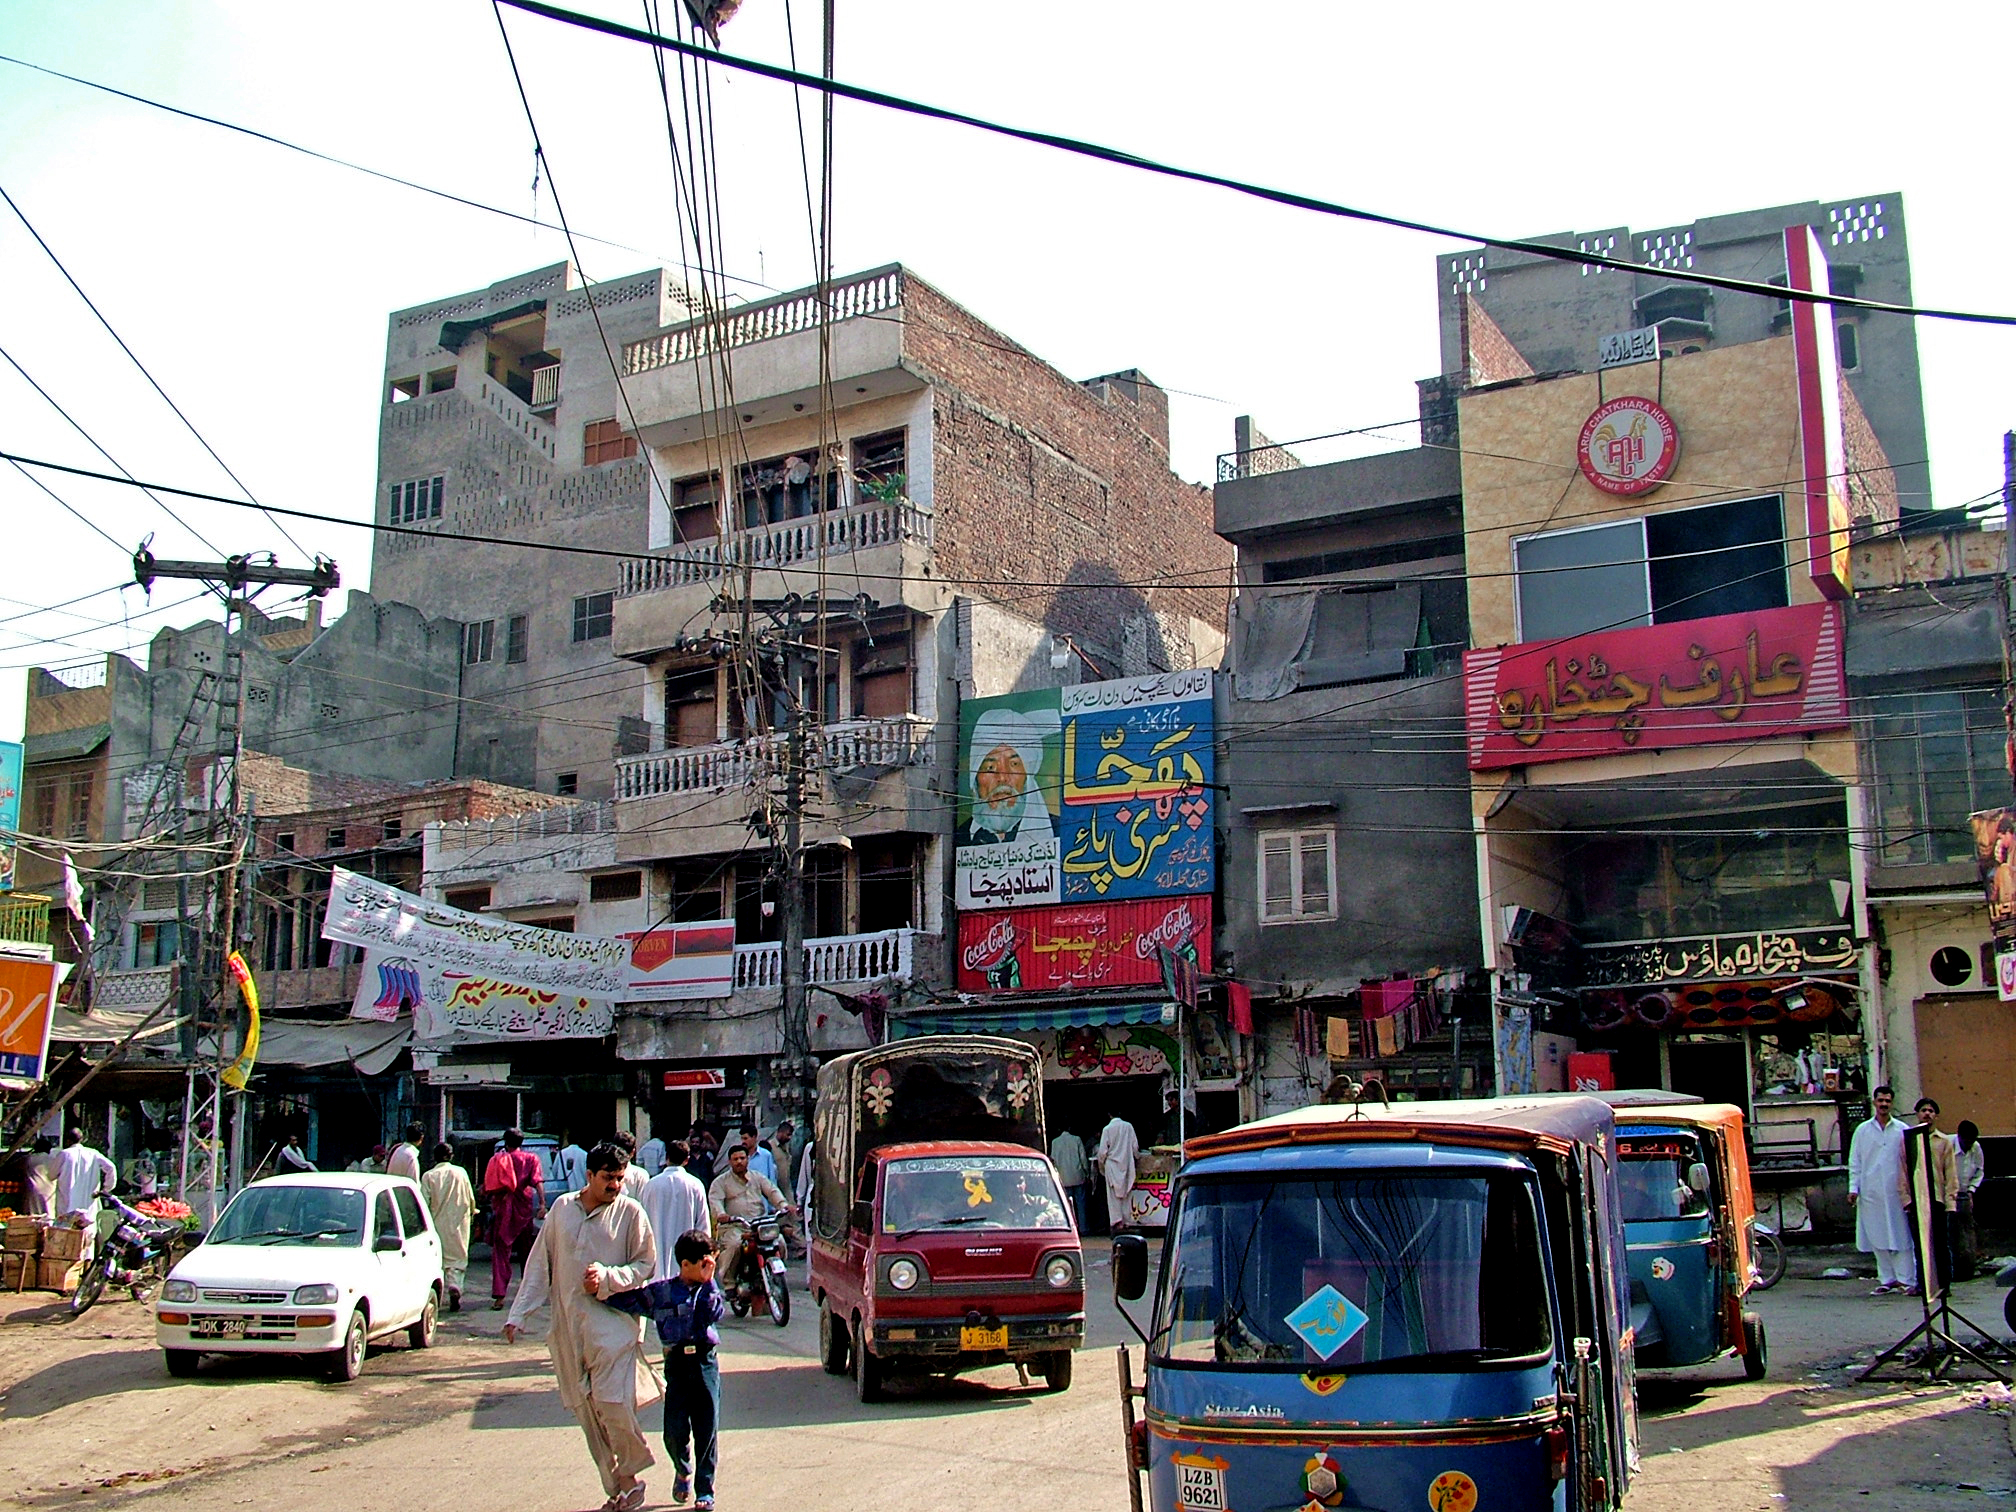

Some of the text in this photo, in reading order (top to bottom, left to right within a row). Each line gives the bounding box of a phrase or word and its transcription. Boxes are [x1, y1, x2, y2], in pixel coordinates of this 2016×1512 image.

[1580, 400, 1673, 454] ARIF CHATKHARA HOUSE
[1598, 477, 1620, 490] NAME
[1624, 482, 1635, 491] OF
[1640, 464, 1664, 486] TASTE
[1173, 672, 1207, 697] نقالوں
[1499, 629, 1801, 746] عارف چٹخارہ
[1084, 686, 1103, 708] رات
[1104, 687, 1119, 706] دن
[1140, 709, 1159, 733] کافی
[1169, 705, 1181, 730] نام
[957, 849, 978, 869] بادشاہ
[979, 847, 995, 869] تاج
[993, 854, 1004, 869] بے
[1024, 843, 1038, 863] کی
[1062, 807, 1180, 894] سری پائے
[1173, 869, 1190, 887] محلہ
[1186, 869, 1209, 888] شاہی
[1100, 938, 1115, 958] دین
[1116, 928, 1134, 953] فضل
[1735, 932, 1802, 975] چٹخارہ
[1802, 936, 1862, 970] رف
[1094, 962, 1112, 979] سری
[223, 1320, 246, 1334] 2840
[1184, 1468, 1214, 1487] LZB
[1183, 1485, 1219, 1506] 9621
